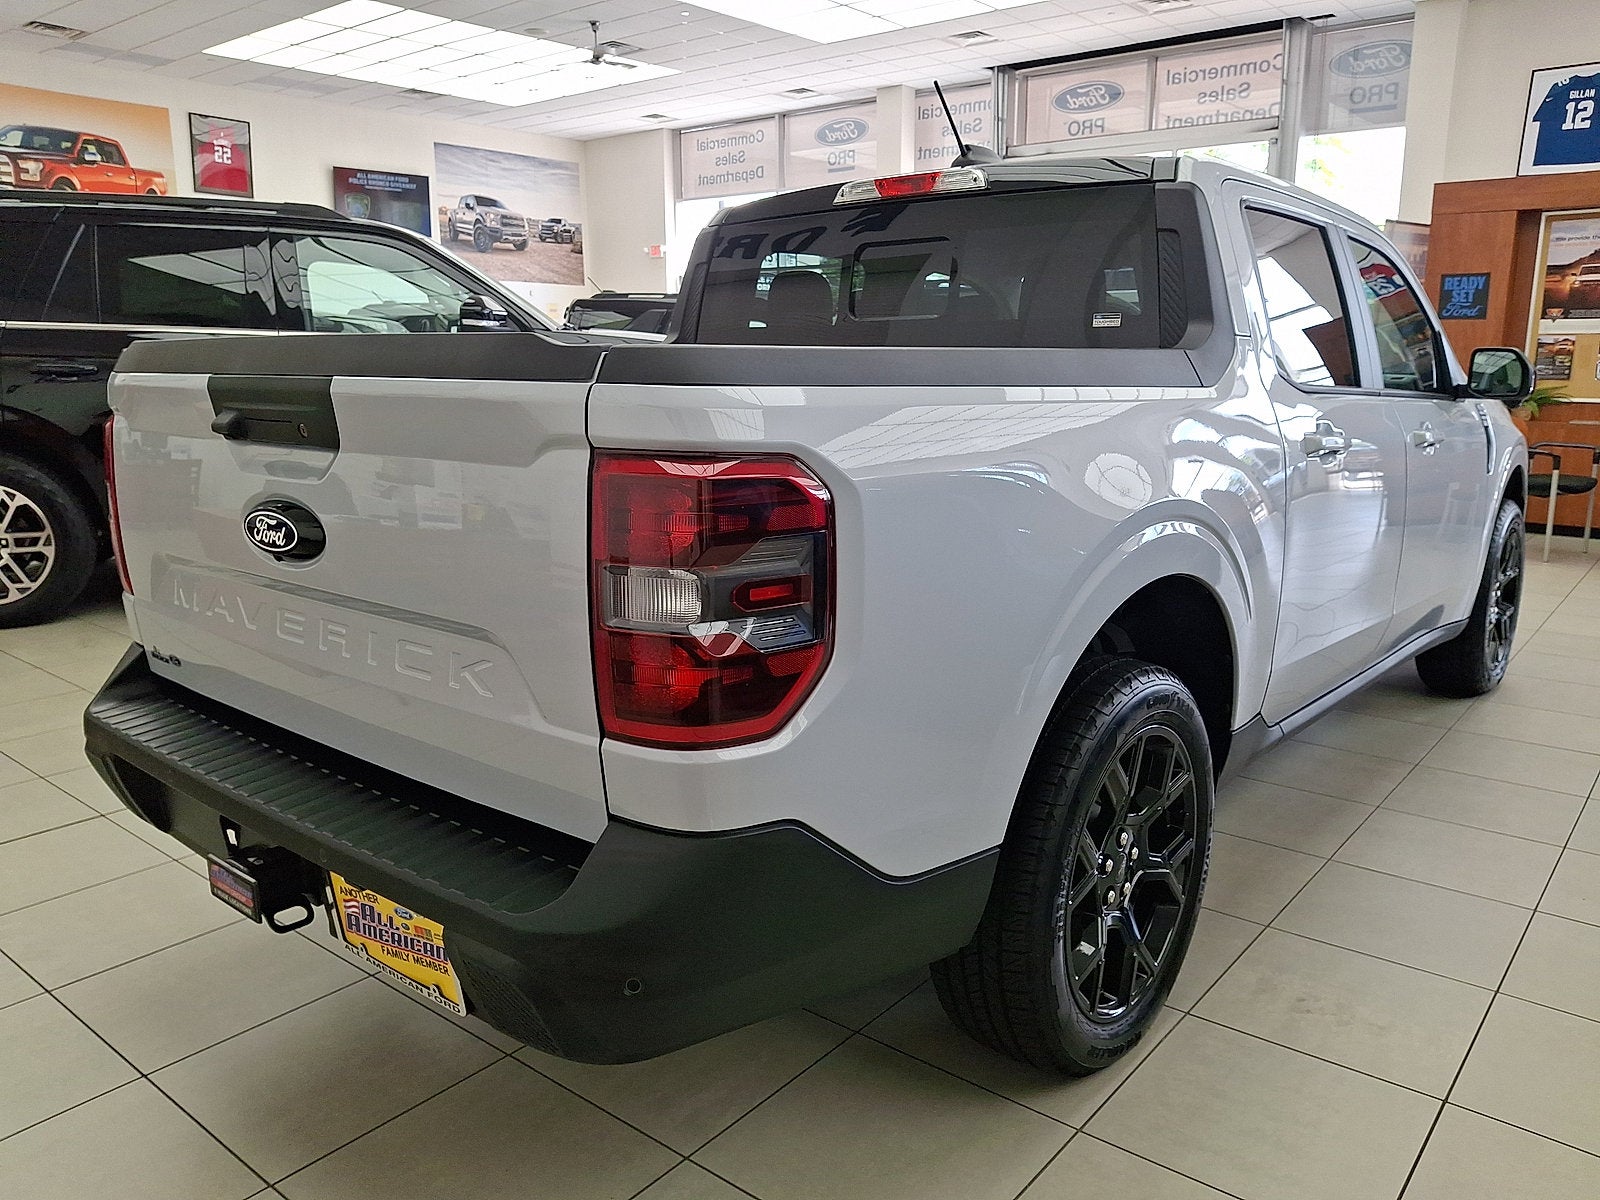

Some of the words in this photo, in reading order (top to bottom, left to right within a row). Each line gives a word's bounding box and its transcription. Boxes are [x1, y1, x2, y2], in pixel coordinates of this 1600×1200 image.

[1569, 88, 1596, 99] GILLAN
[1561, 99, 1595, 131] 12
[213, 145, 232, 165] 22
[1444, 275, 1487, 290] READY
[1451, 289, 1476, 303] SET
[1441, 302, 1484, 317] Ford
[253, 515, 287, 547] Ford
[173, 578, 494, 698] MAVERICK
[339, 885, 381, 905] ANOTHER
[381, 945, 411, 963] FAMILY
[413, 954, 451, 977] MEMBER
[344, 943, 364, 959] ALL
[366, 957, 424, 994] AMERICAN
[427, 992, 462, 1014] FORD
